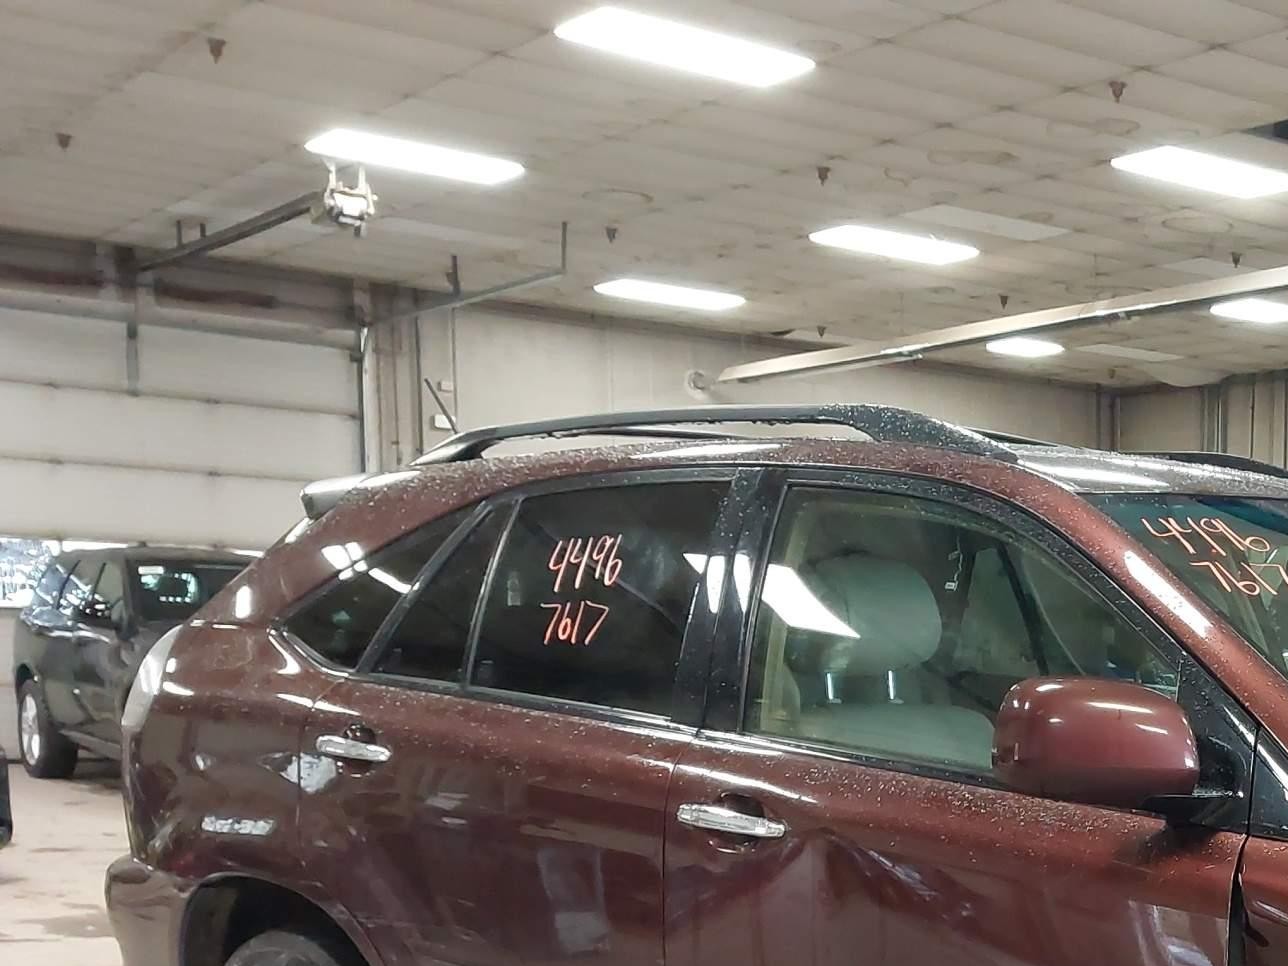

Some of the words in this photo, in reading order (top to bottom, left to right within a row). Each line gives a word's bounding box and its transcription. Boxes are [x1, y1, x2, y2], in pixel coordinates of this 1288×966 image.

[1141, 516, 1271, 557] 4496
[549, 533, 622, 593] 4496
[540, 599, 609, 646] 7617
